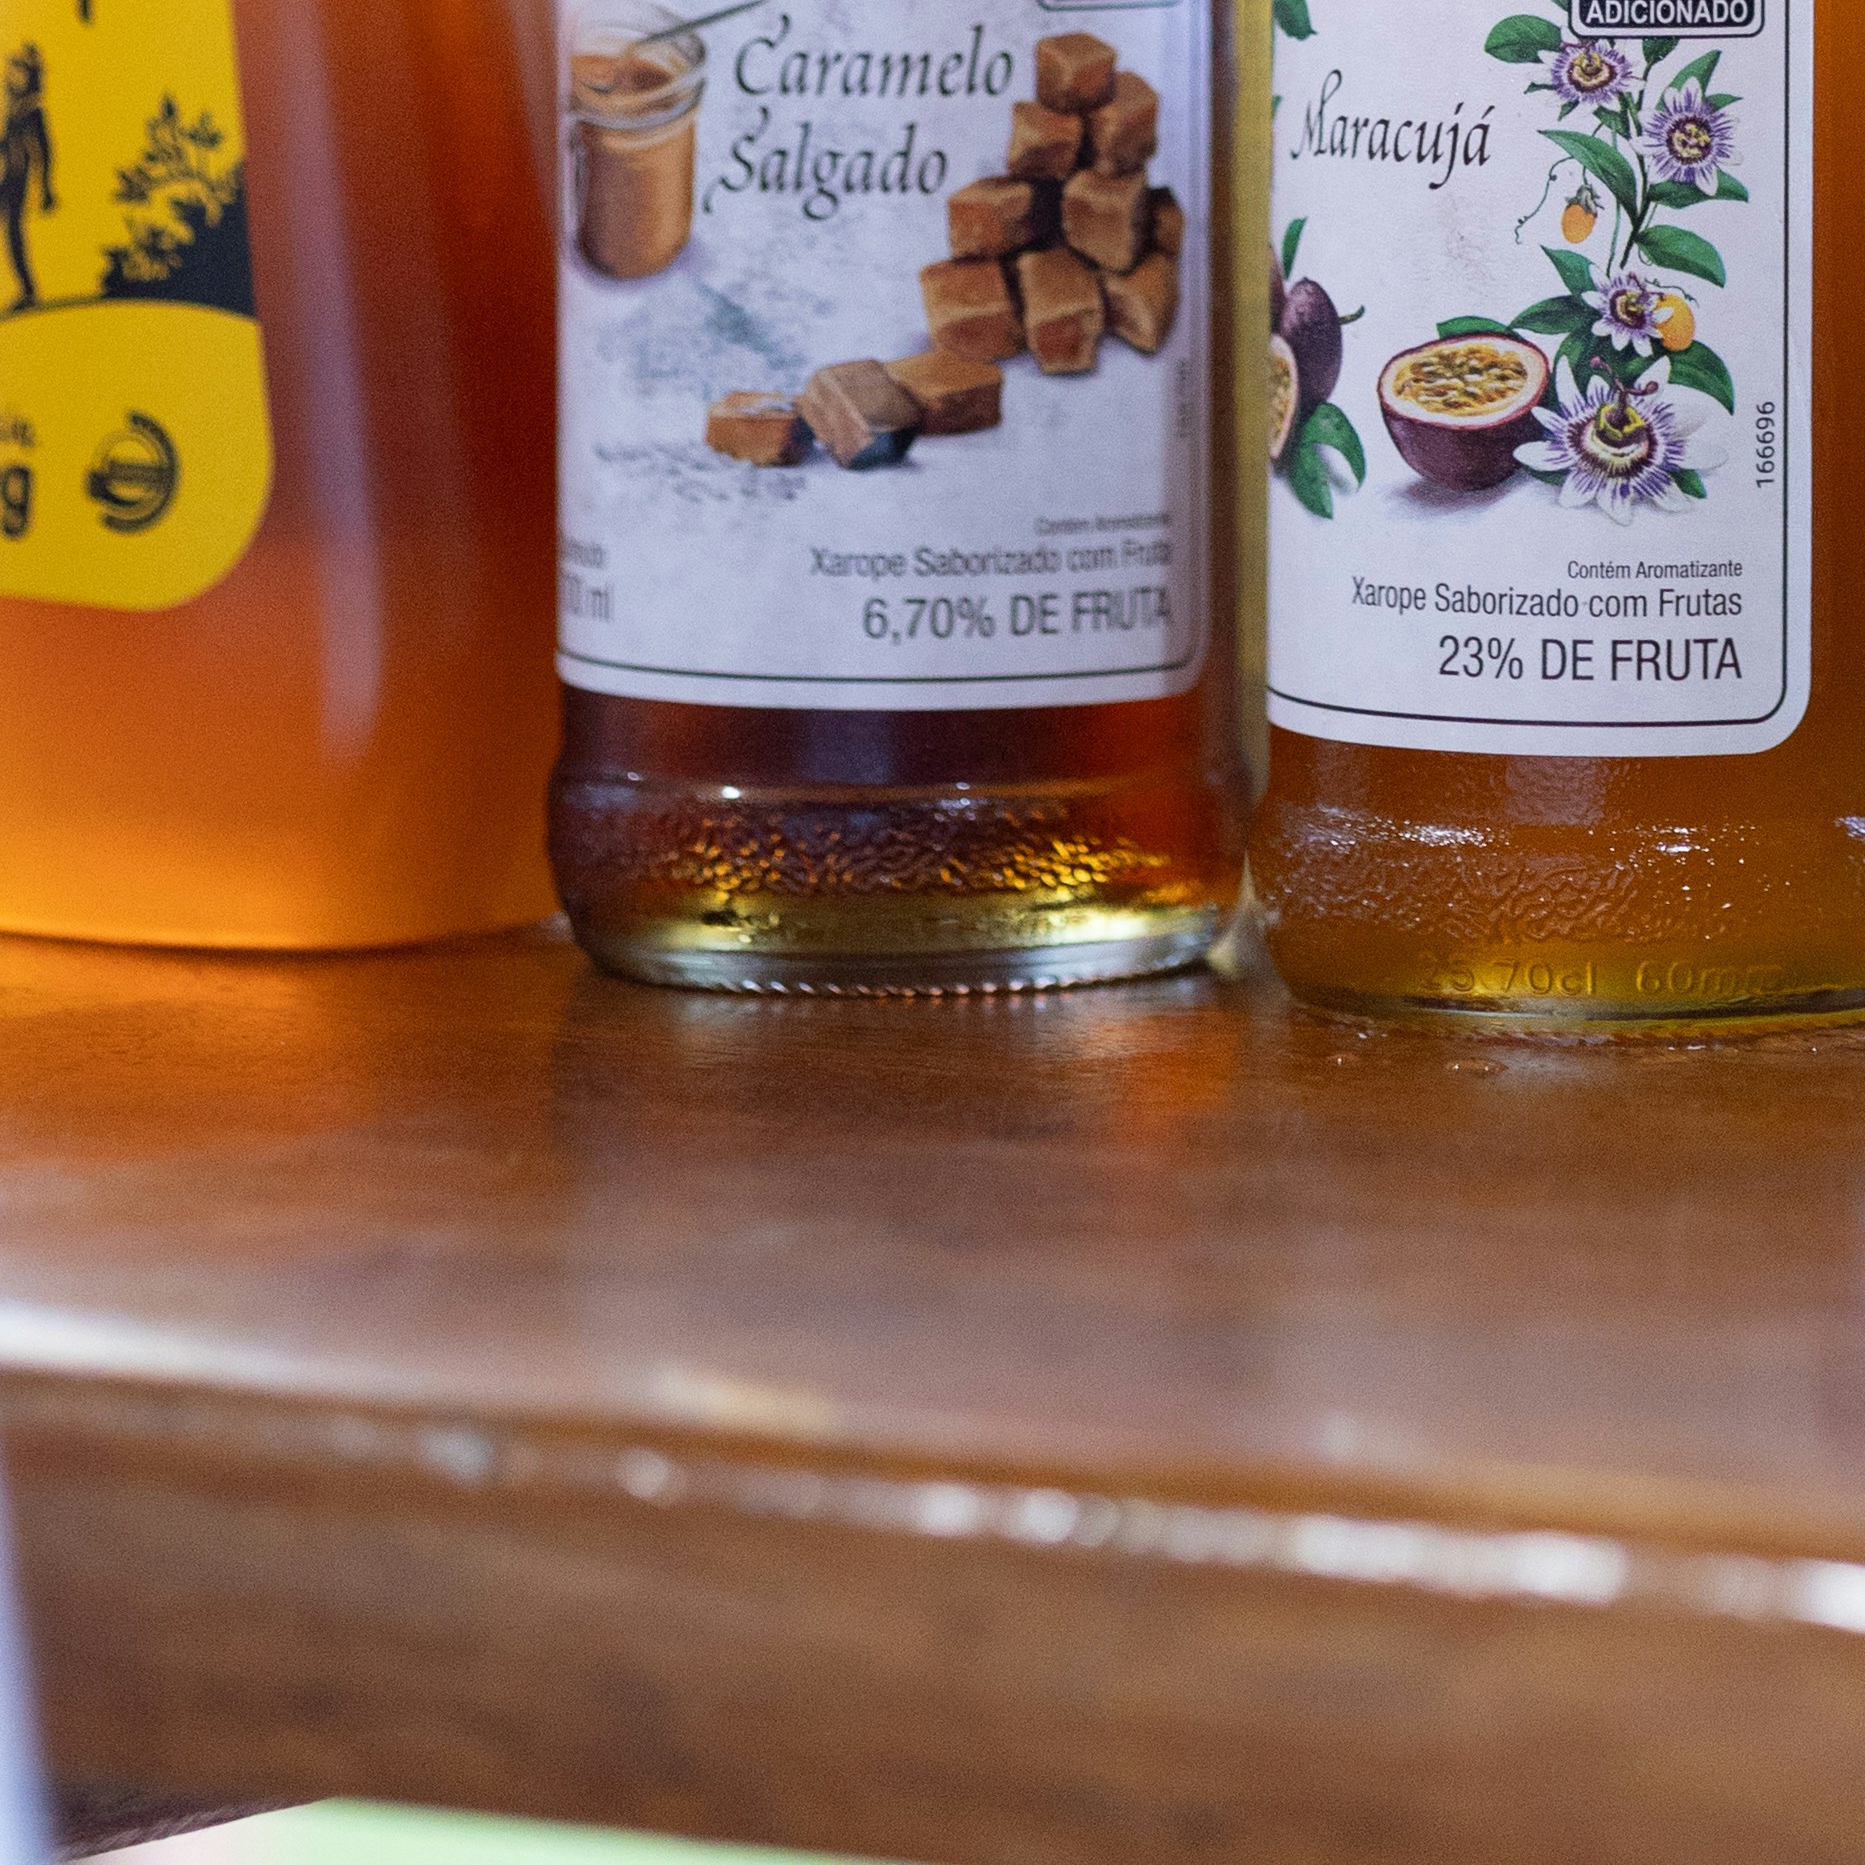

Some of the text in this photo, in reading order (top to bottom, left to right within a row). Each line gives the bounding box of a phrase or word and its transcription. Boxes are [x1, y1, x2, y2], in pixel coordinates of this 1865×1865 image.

[734, 14, 1015, 99] Caramelo
[703, 108, 951, 222] Salgado
[1290, 69, 1496, 190] Maracujá
[1754, 400, 1777, 488] 166696
[1351, 576, 1743, 618] Xarope Saborizado com Frutas
[1567, 559, 1744, 579] Contém Aromatizante
[862, 586, 1172, 646] 6,70% DE FRUTA
[1437, 634, 1743, 681] 23% DE FRUTA
